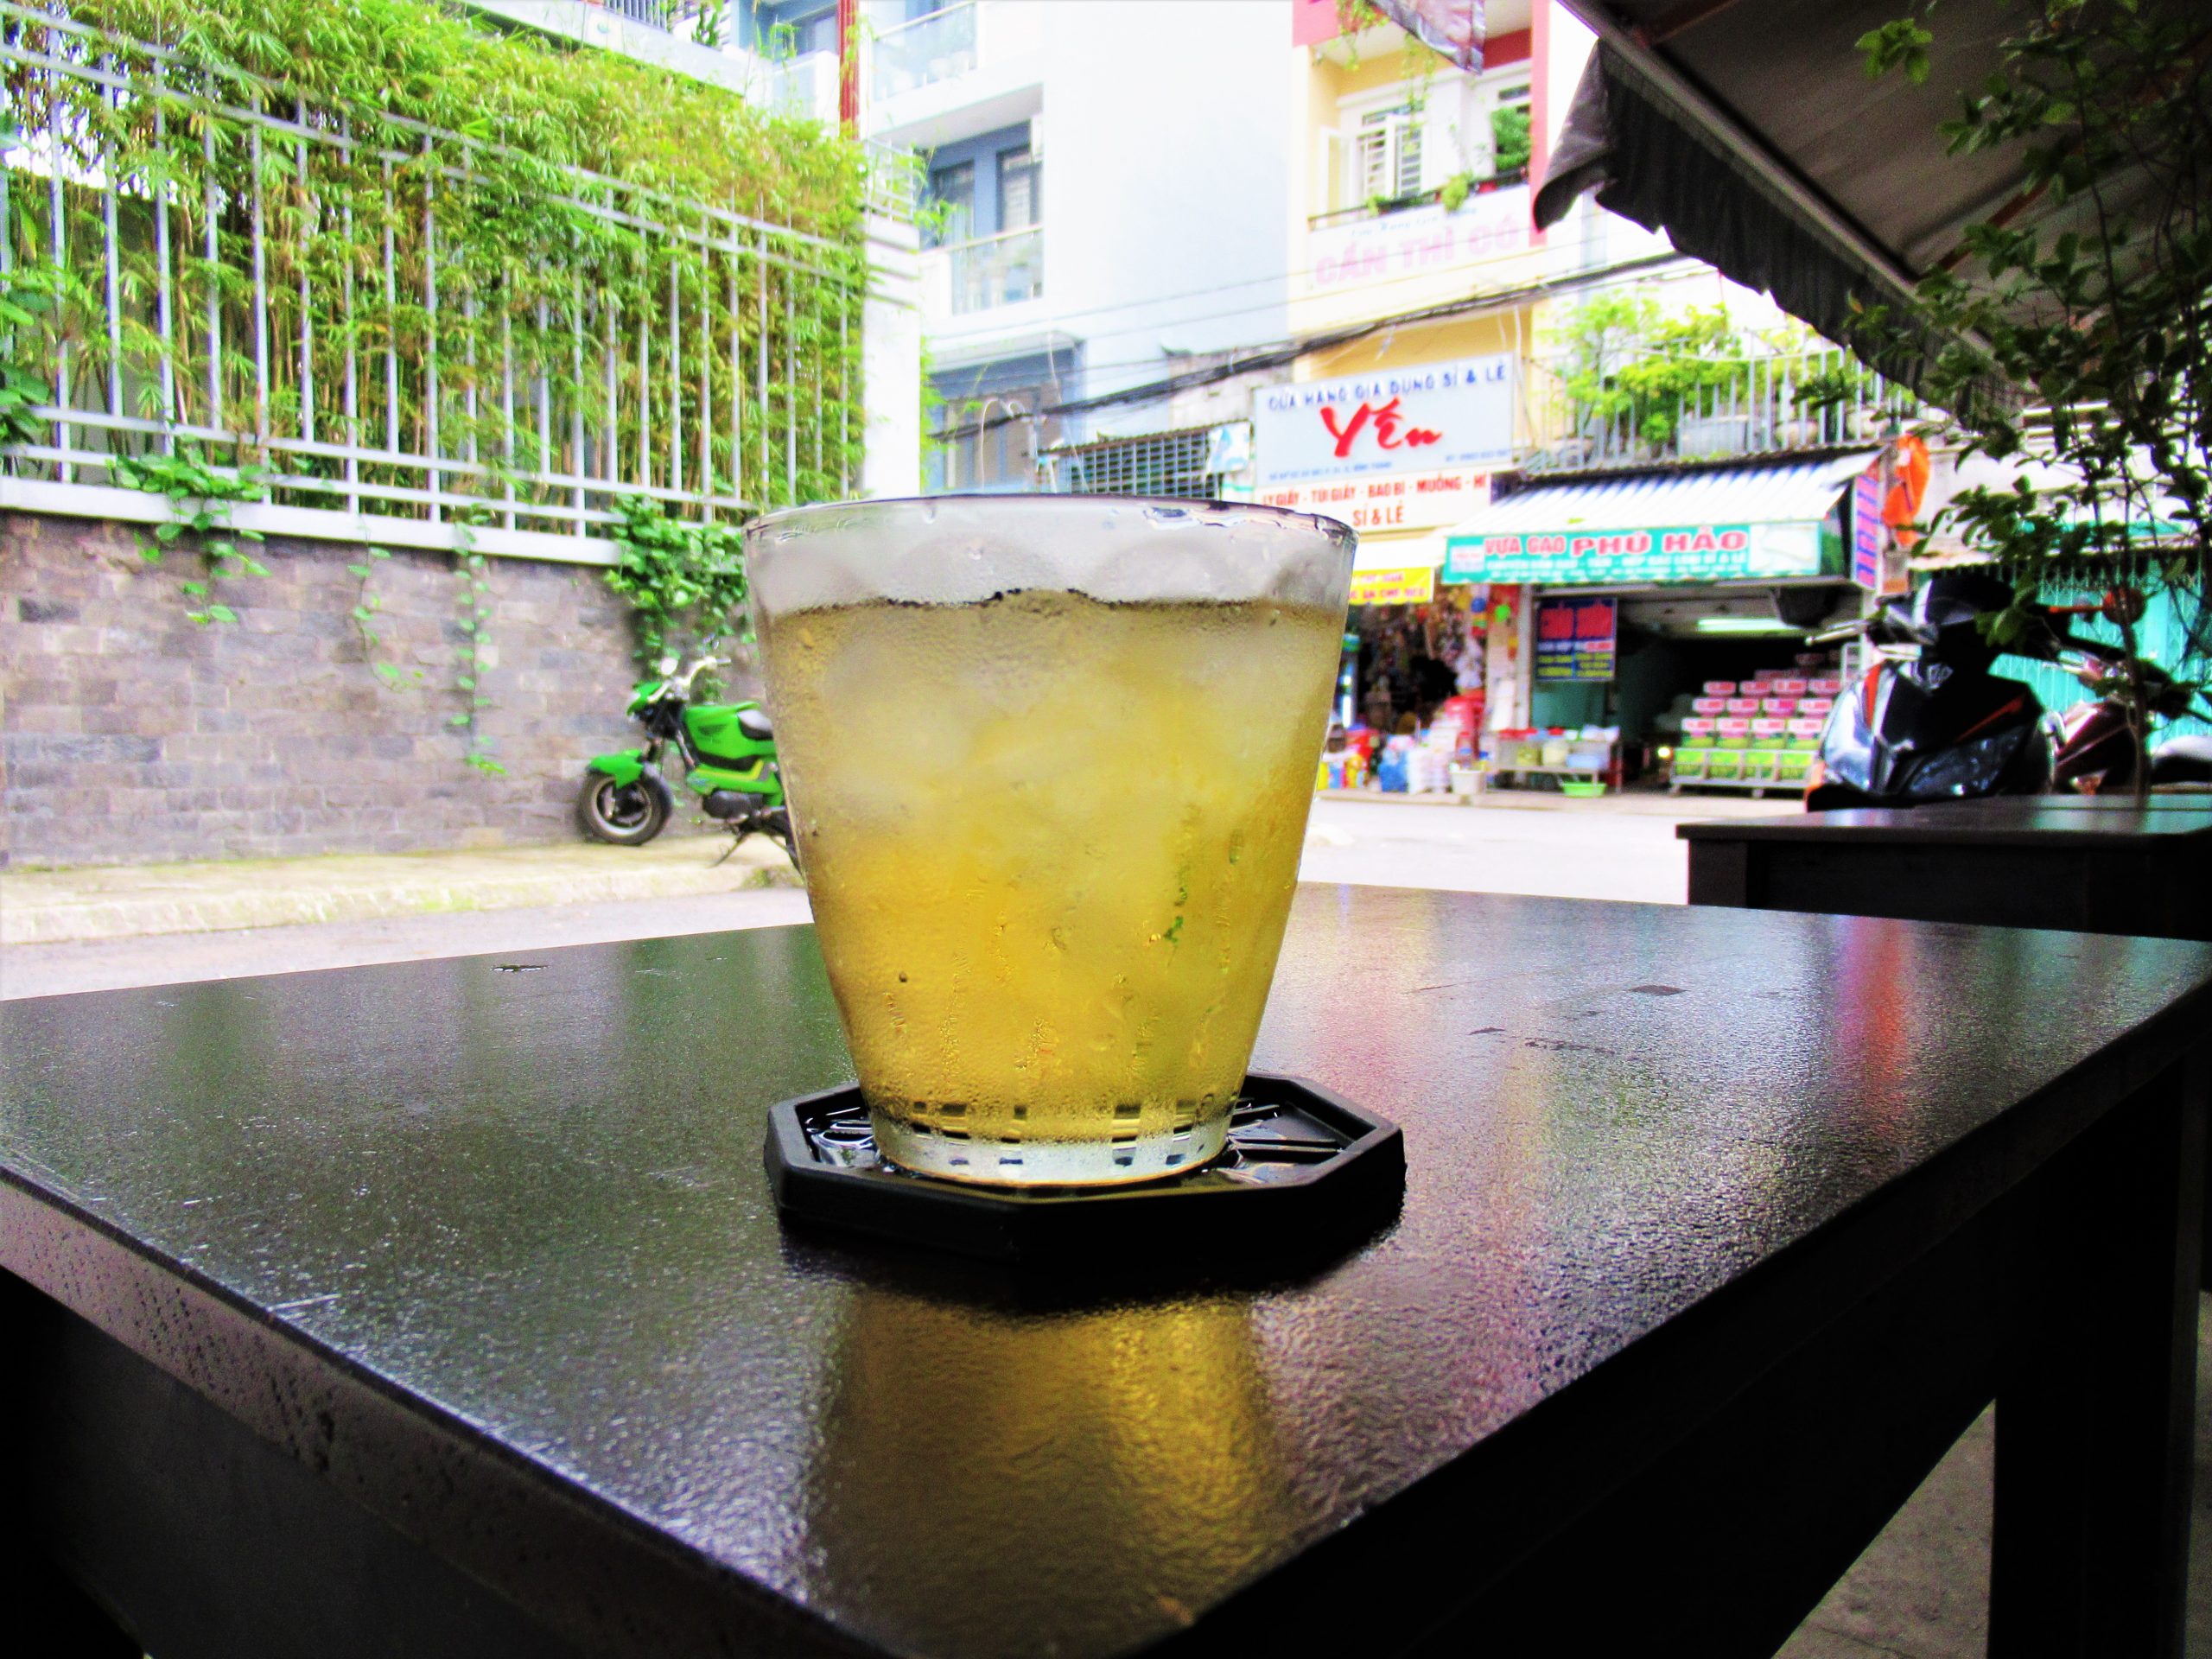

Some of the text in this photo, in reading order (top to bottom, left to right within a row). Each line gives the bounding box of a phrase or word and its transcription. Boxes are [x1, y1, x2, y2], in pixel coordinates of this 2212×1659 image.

[1319, 396, 1443, 458] Yến
[1368, 483, 1392, 499] BAO
[1370, 508, 1382, 526] &
